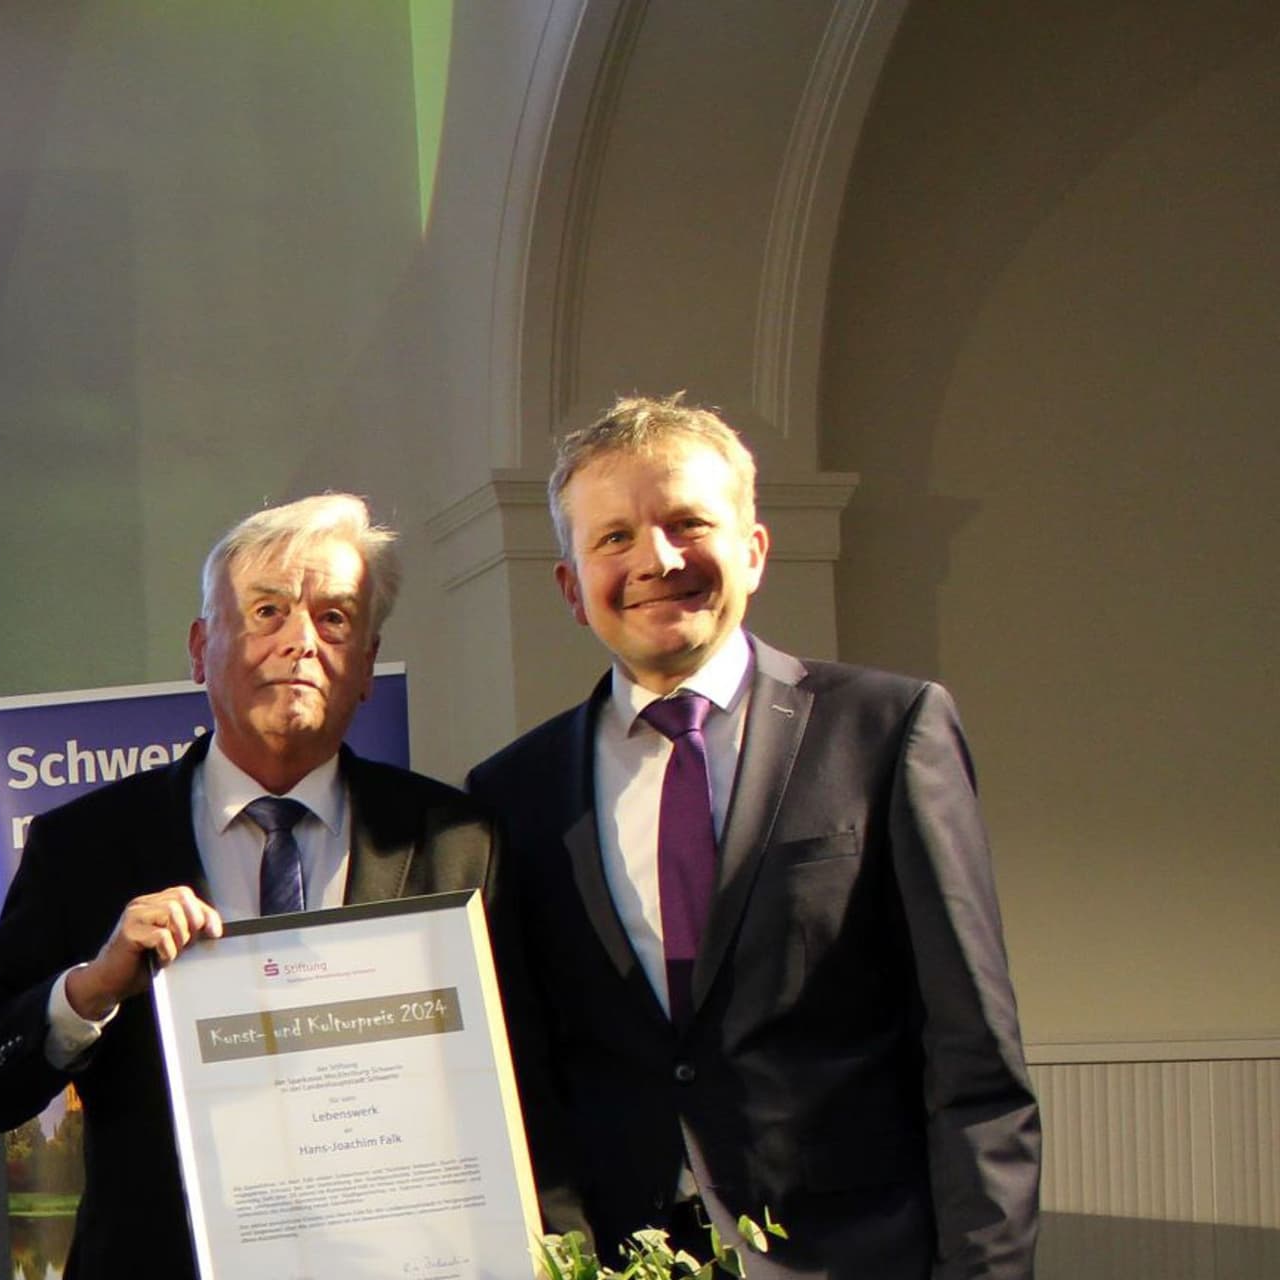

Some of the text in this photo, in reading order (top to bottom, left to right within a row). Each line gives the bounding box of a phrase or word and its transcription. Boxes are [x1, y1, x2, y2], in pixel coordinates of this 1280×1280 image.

[284, 961, 328, 975] Stiftung
[211, 999, 447, 1047] Kunst- und Kulturpreis 2024
[311, 1104, 379, 1122] Lebenswerk
